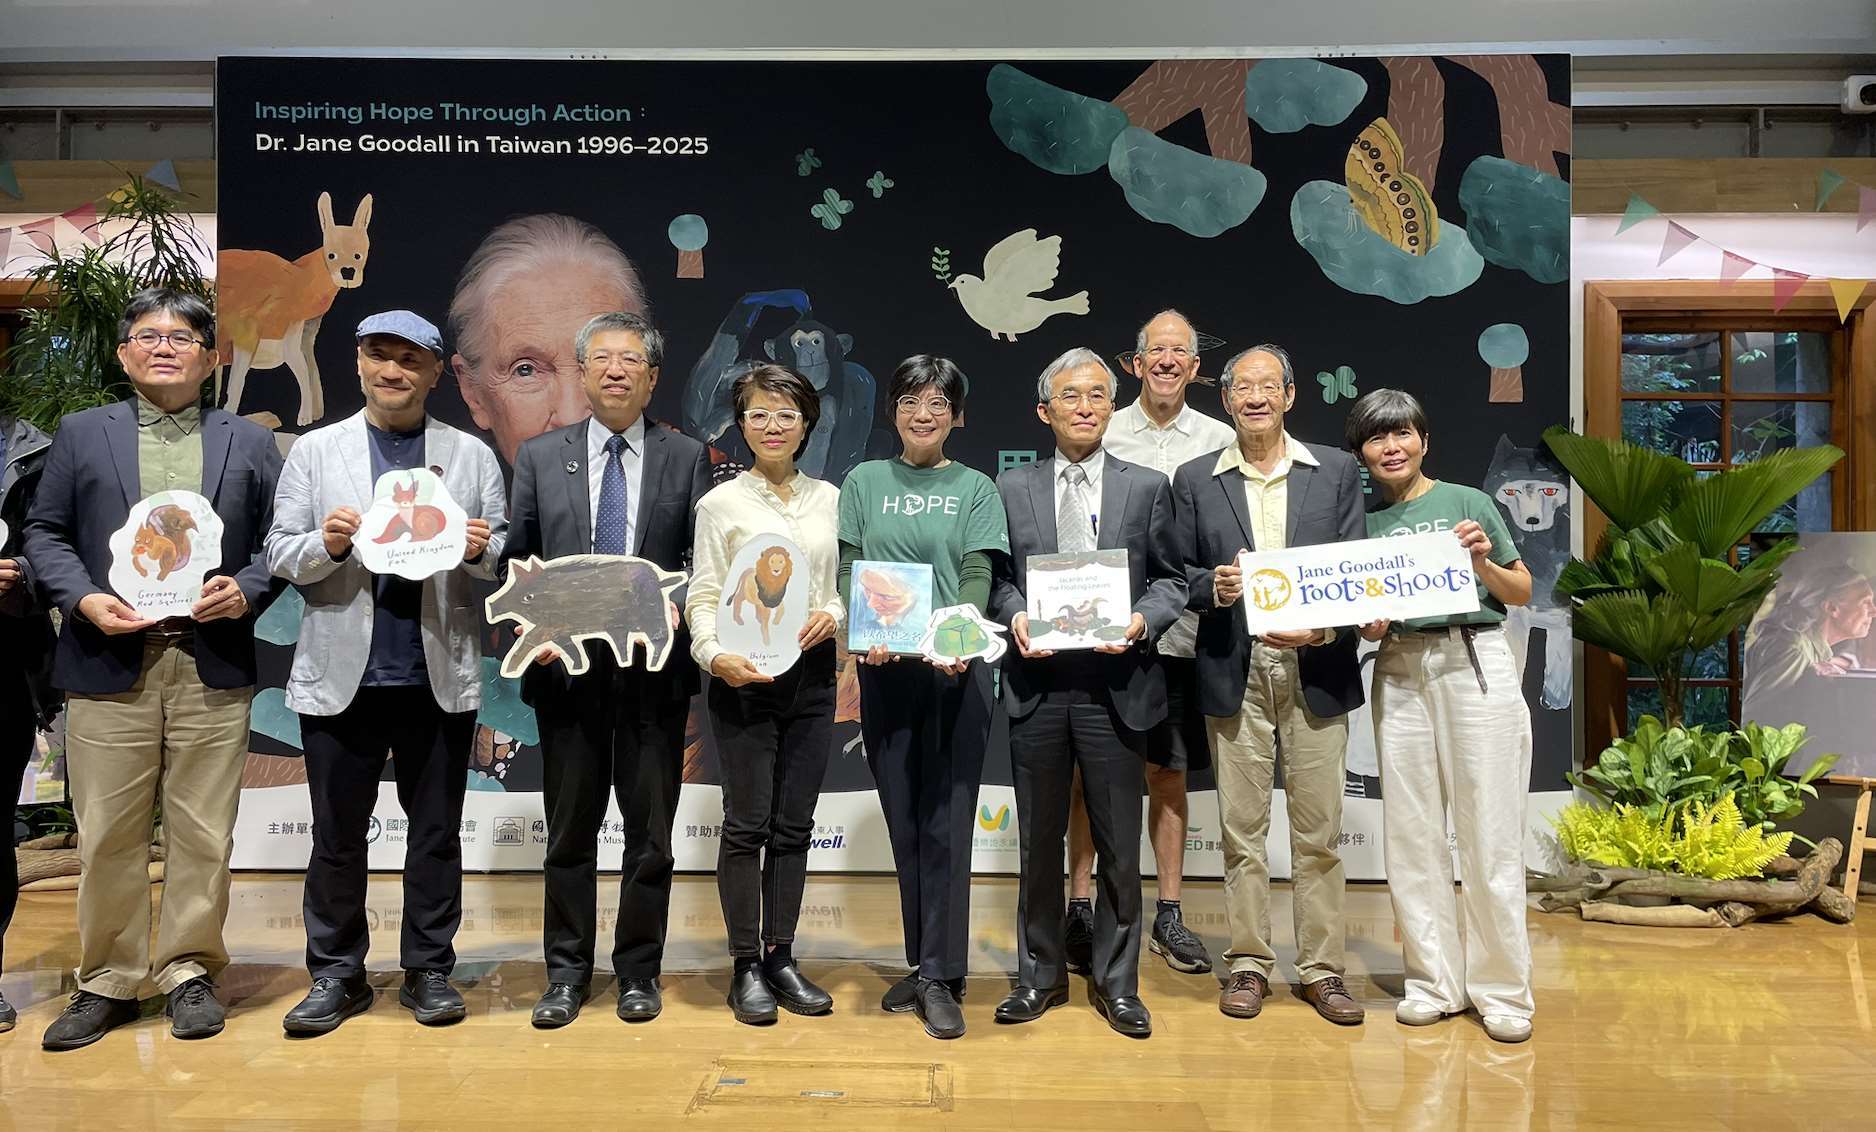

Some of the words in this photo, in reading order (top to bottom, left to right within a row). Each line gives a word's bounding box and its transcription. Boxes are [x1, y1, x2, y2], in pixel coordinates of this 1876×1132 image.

[255, 101, 363, 123] Inspiring
[369, 102, 434, 124] Hope
[440, 102, 547, 126] Through
[552, 103, 632, 122] Action
[255, 133, 288, 152] Dr.
[293, 134, 352, 152] Jane
[358, 134, 451, 153] Goodall
[457, 135, 480, 153] in
[486, 135, 572, 154] Taiwan
[387, 549, 416, 559] United
[420, 543, 454, 555] Kingdom
[1297, 564, 1334, 583] Jane
[1339, 553, 1416, 575] Goodall's
[138, 590, 178, 600] Germany
[267, 822, 313, 835] 主辦單
